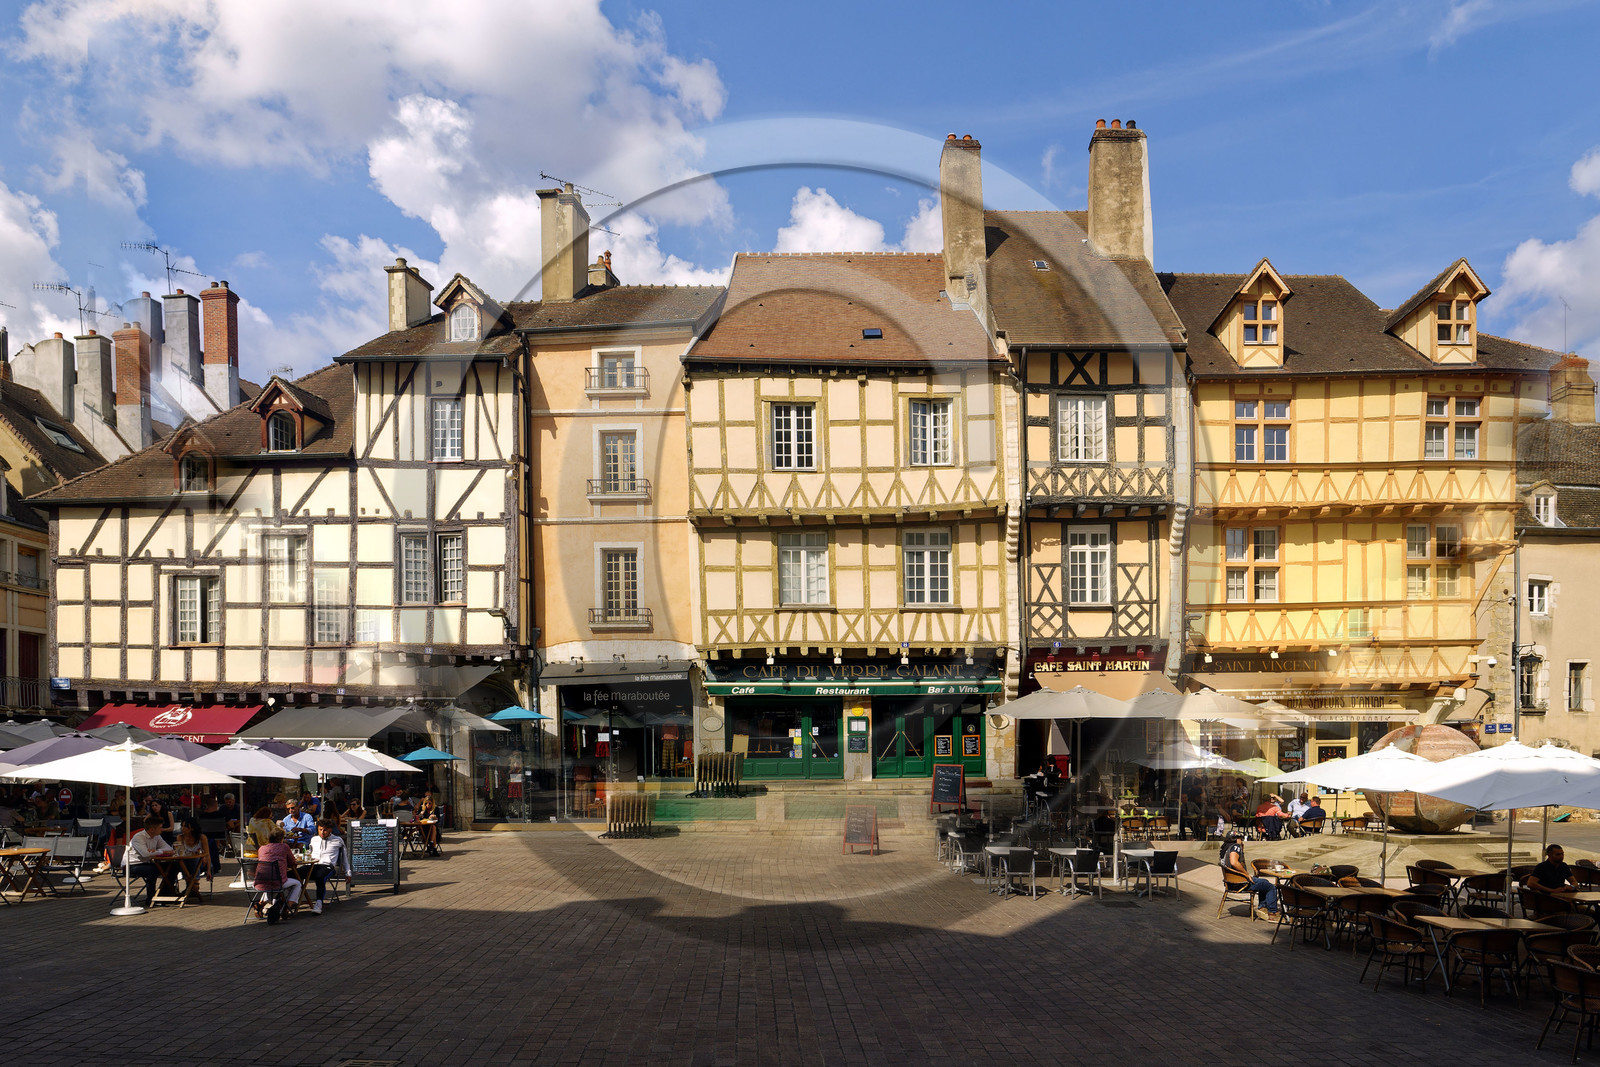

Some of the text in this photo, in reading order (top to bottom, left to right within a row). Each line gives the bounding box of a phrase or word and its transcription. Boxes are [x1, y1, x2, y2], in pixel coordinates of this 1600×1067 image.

[743, 665, 788, 678] CAFE
[797, 665, 820, 678] DU
[827, 664, 889, 678] VERRE
[895, 664, 964, 677] GALANT
[1034, 660, 1150, 672] CAFE SAINT MARTIN
[1214, 660, 1255, 671] SAINT
[1261, 661, 1321, 671] VINCENT
[731, 685, 979, 695] Café Restaurant Bar à Vins
[583, 689, 670, 706] la fée maraboutée
[1287, 698, 1303, 708] AUX
[1308, 696, 1345, 709] SAVEURS
[181, 735, 205, 743] CENT
